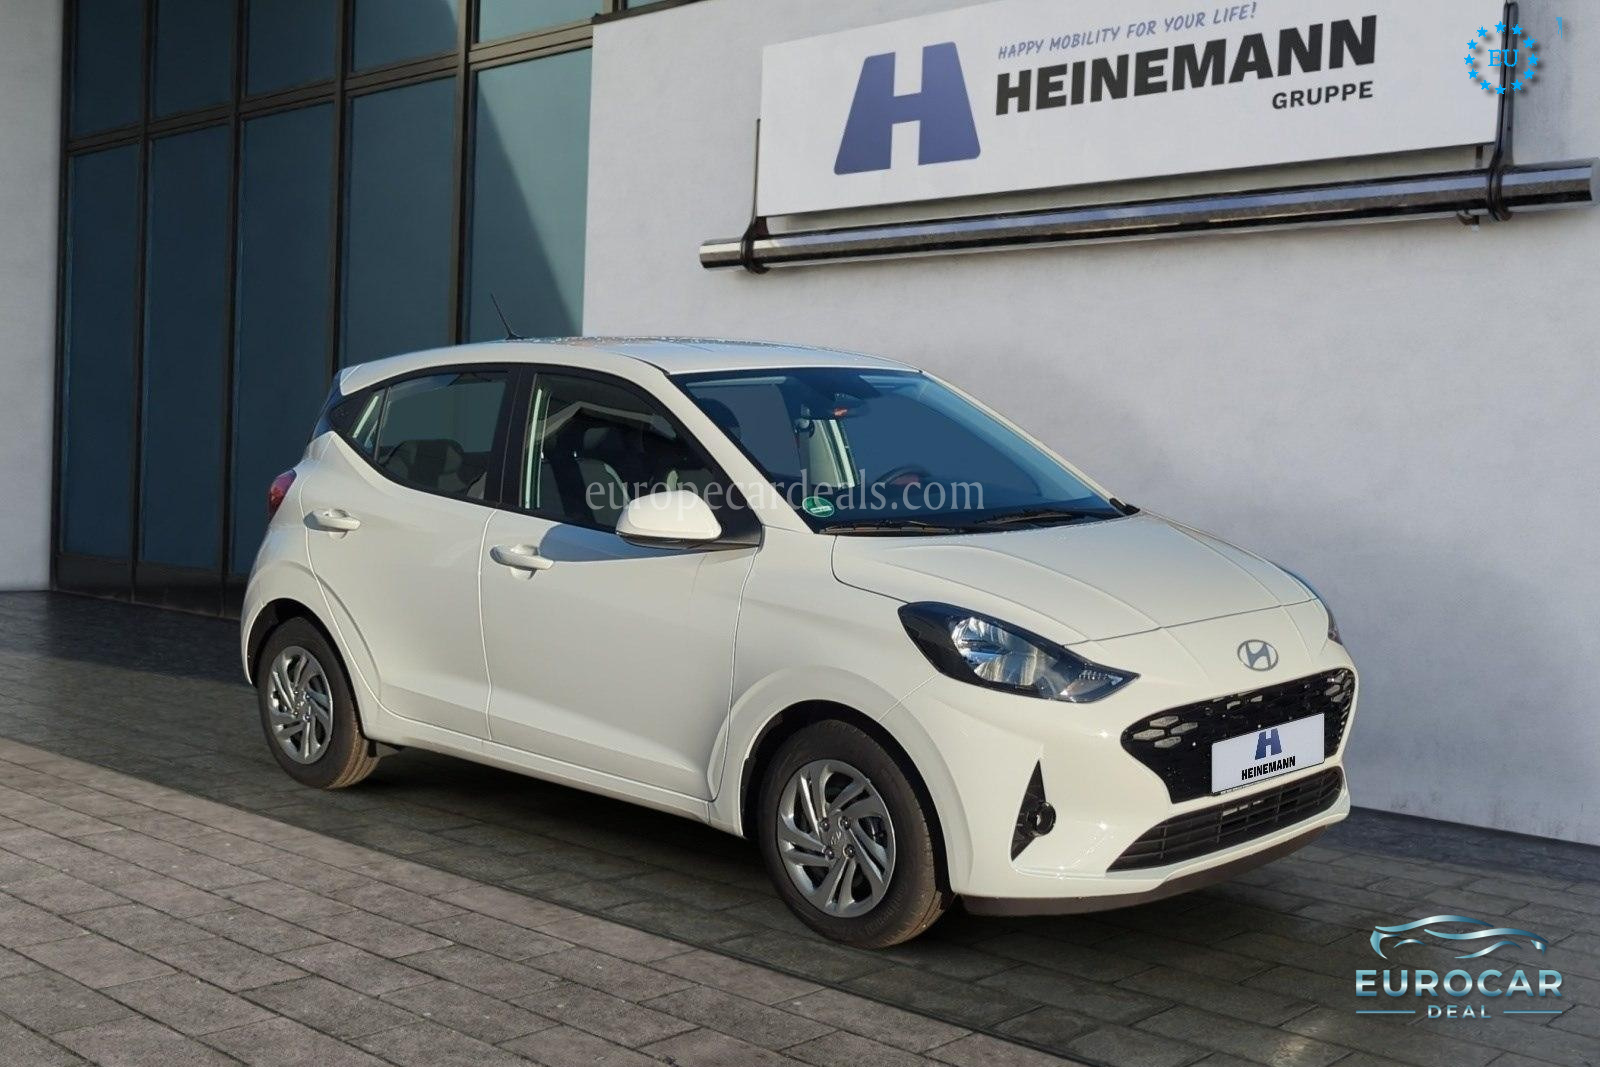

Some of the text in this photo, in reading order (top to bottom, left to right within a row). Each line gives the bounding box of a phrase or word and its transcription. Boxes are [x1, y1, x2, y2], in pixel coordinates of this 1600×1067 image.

[997, 2, 1257, 60] HAPPY MOBILITY FOR YOUR LIFE!
[995, 15, 1378, 116] HEINEMANN
[833, 41, 981, 175] H
[1272, 81, 1374, 110] GRUPPE
[1255, 728, 1282, 760] H
[1241, 756, 1296, 780] HEINEMANN
